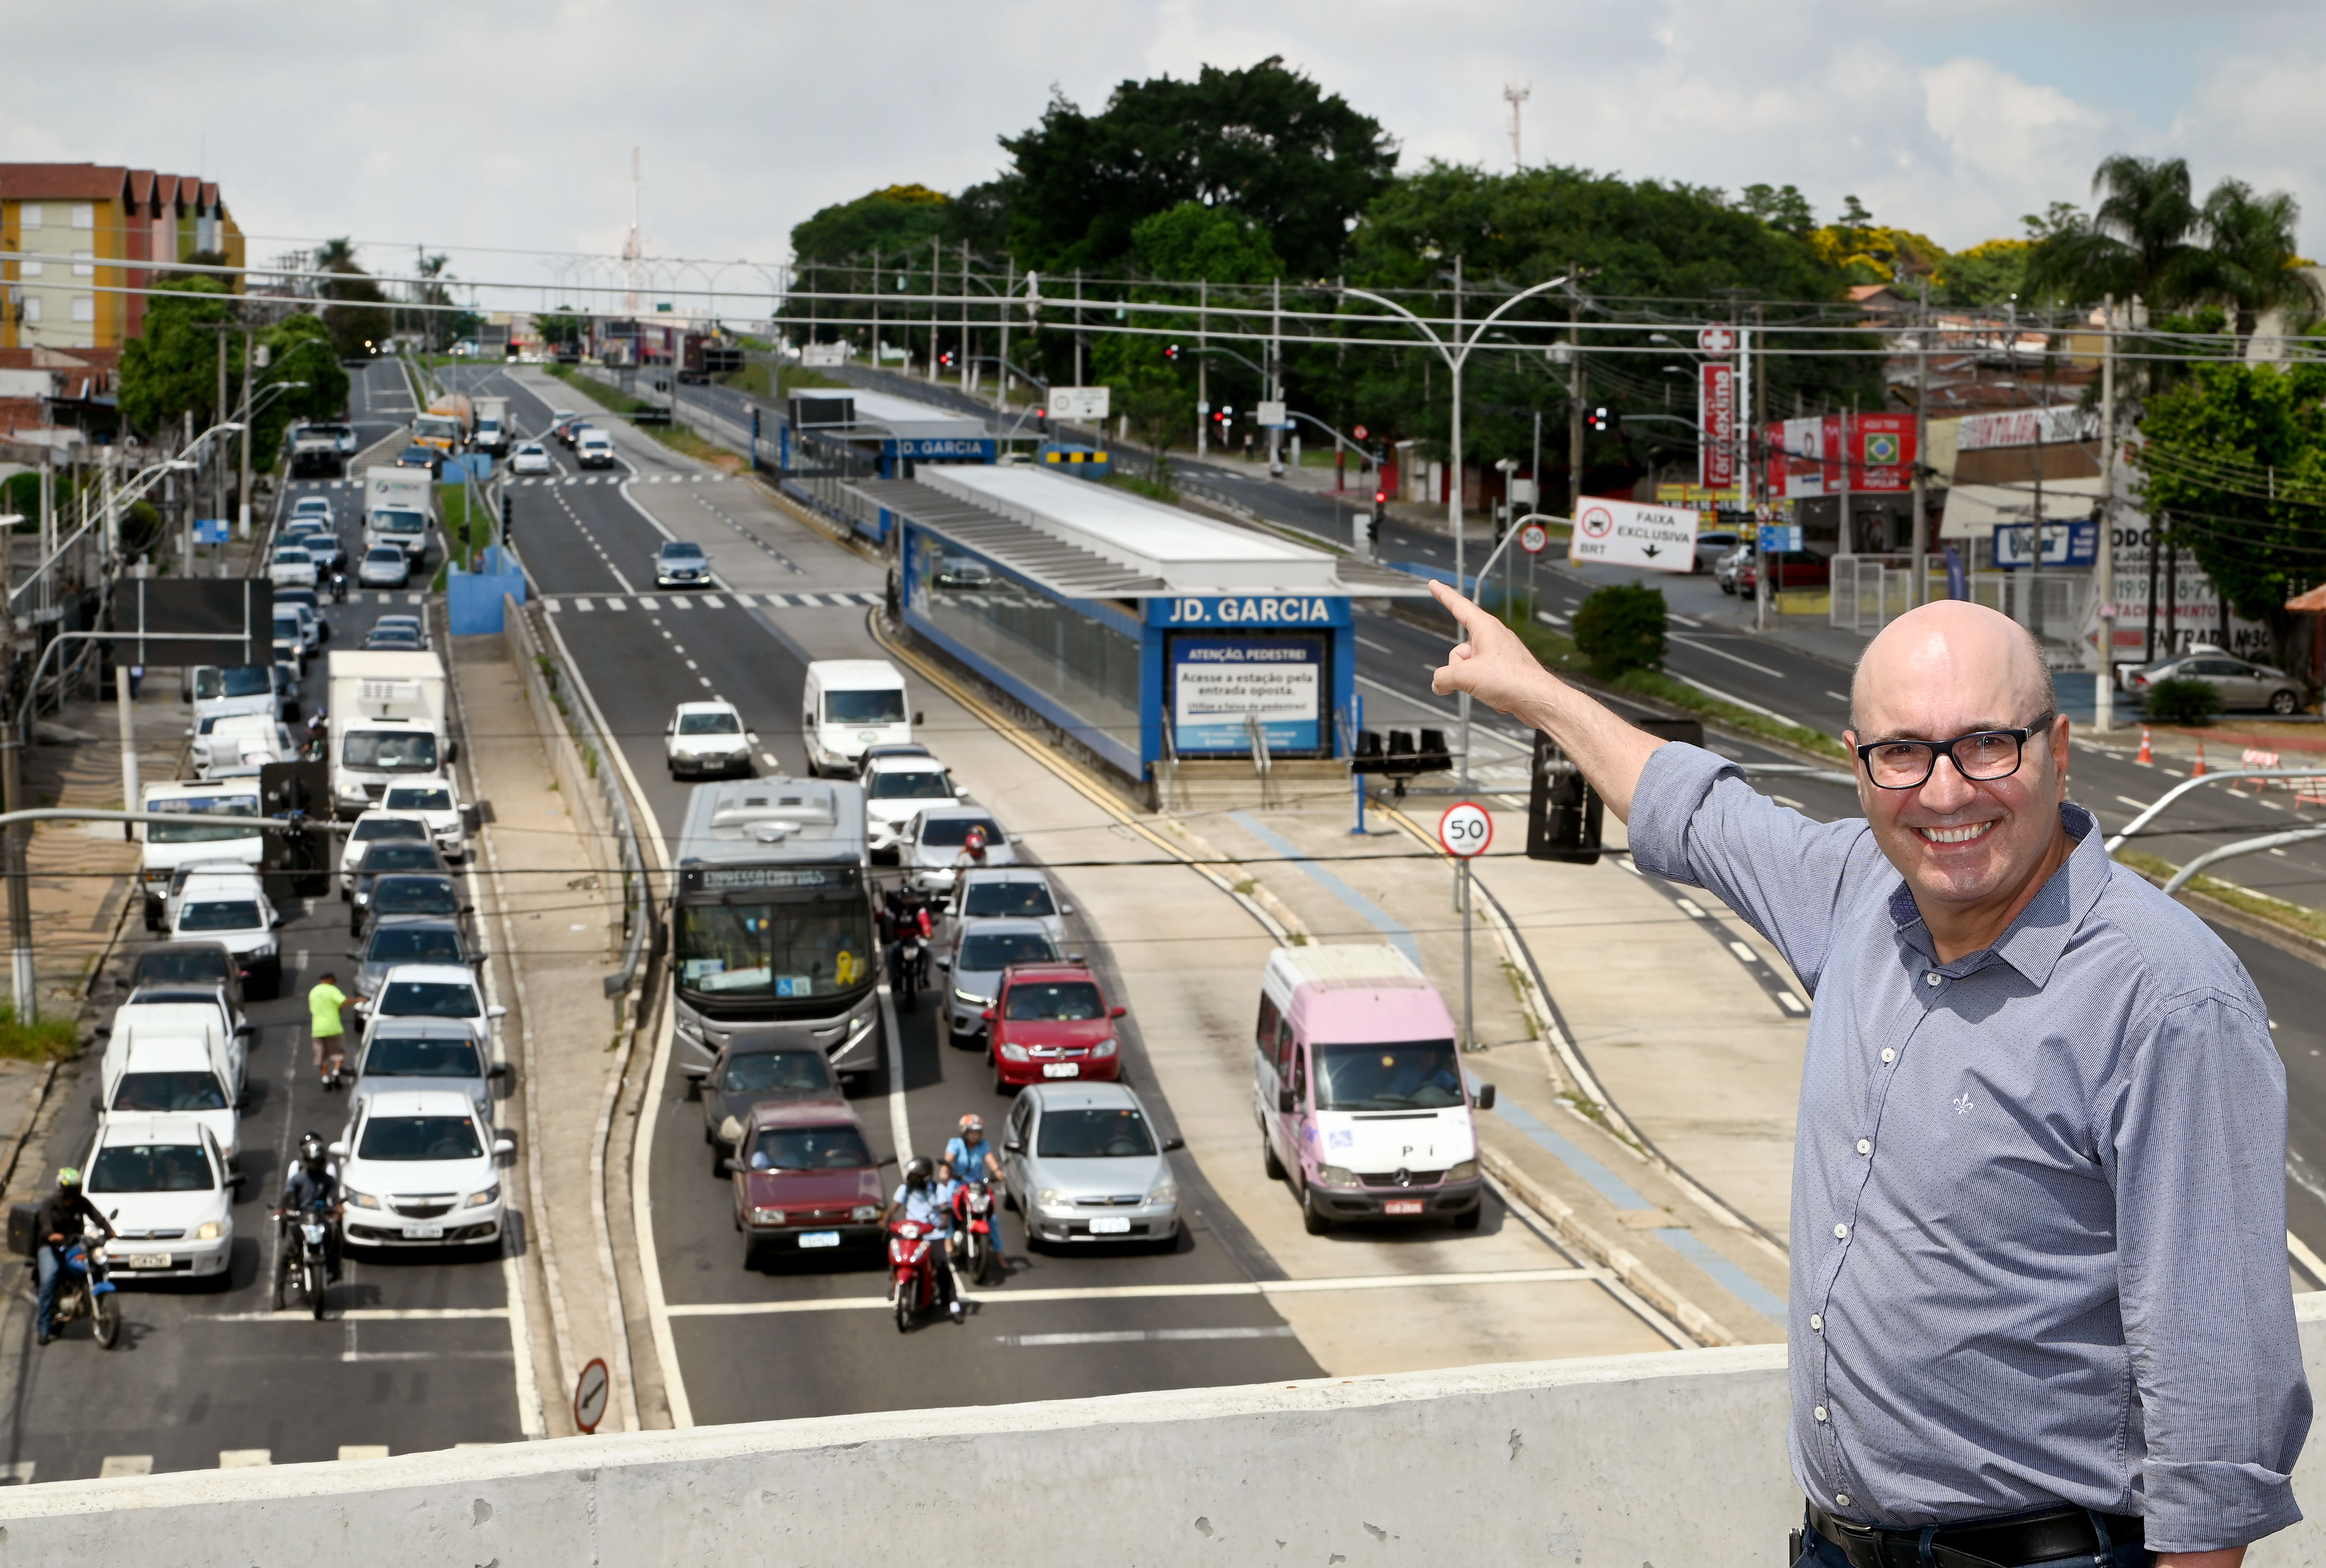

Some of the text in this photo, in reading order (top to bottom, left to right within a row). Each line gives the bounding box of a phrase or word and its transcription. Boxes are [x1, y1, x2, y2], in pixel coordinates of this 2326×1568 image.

[921, 440, 982, 454] GARCIA
[1636, 511, 1675, 526] FAIXA
[1617, 525, 1690, 543] EXCLUSIVA
[1580, 542, 1606, 555] BRT
[1170, 598, 1329, 622] JD. GARCIA
[1189, 647, 1307, 662] ATENÇÃO, PEDESTRE!
[1182, 672, 1222, 682] Acesse
[1236, 672, 1283, 684] estação
[1286, 672, 1313, 684] pela
[1198, 686, 1296, 697] entrada oposta.
[1451, 820, 1483, 839] 50
